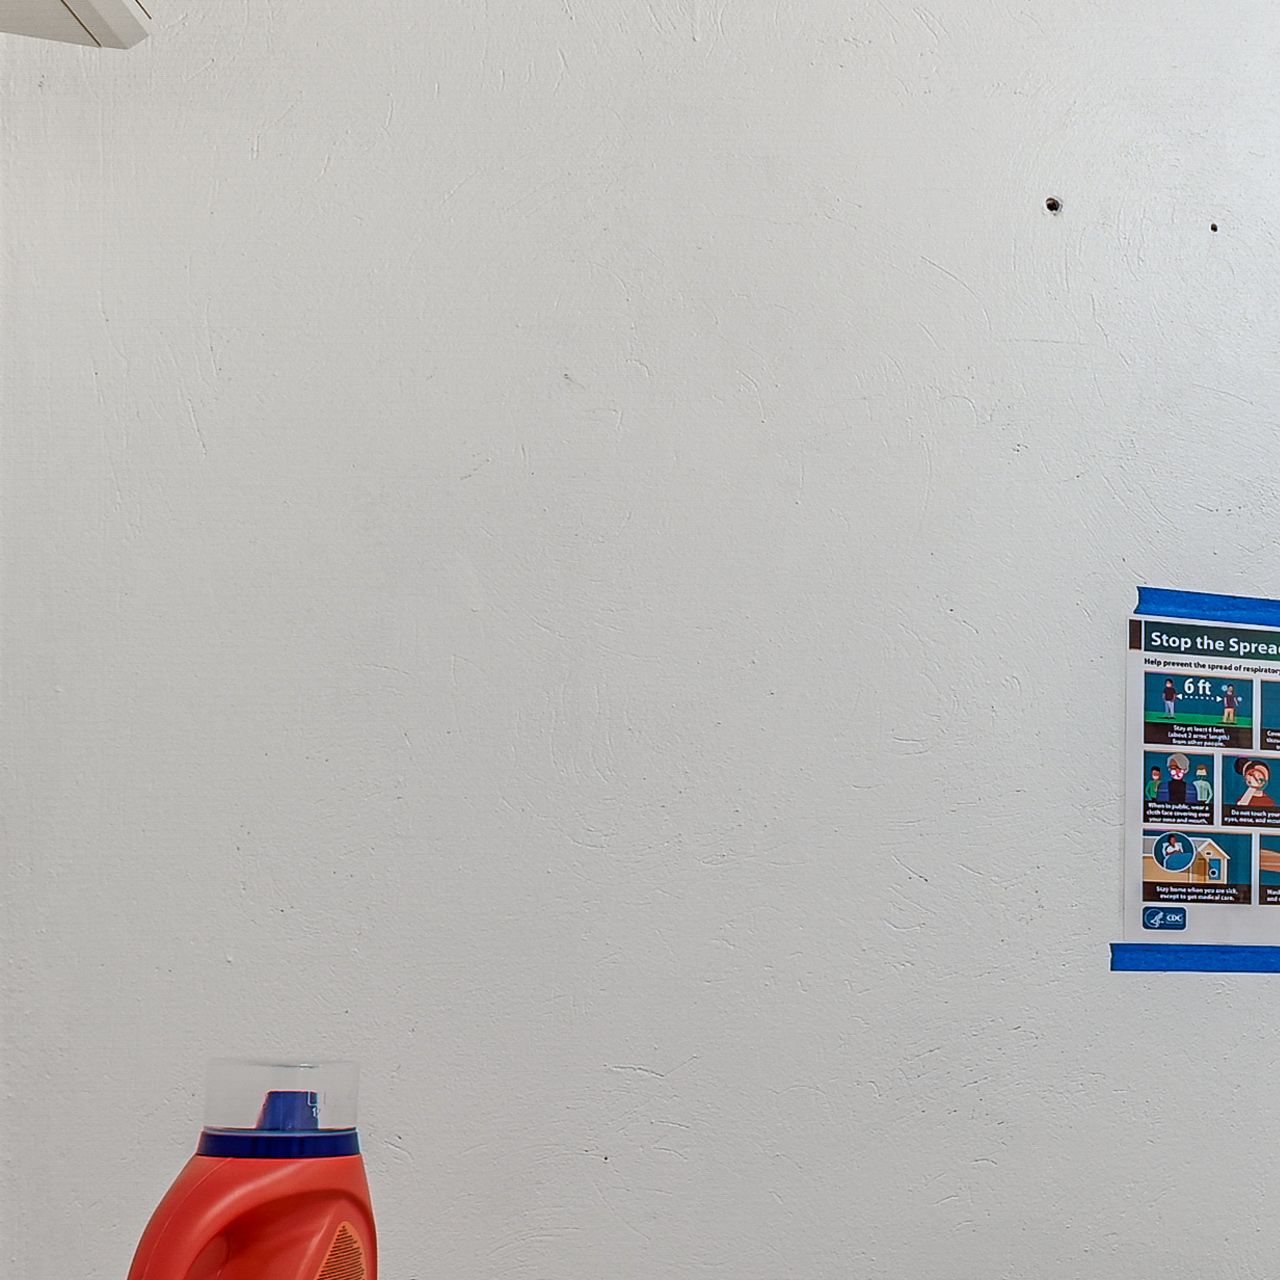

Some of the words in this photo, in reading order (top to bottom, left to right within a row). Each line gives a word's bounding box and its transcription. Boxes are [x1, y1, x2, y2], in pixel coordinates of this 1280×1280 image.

[1151, 632, 1191, 651] Stop
[1196, 635, 1224, 651] the
[1144, 658, 1162, 668] Help
[1164, 661, 1192, 669] prevent
[1184, 679, 1194, 694] 6
[1198, 680, 1211, 695] ft
